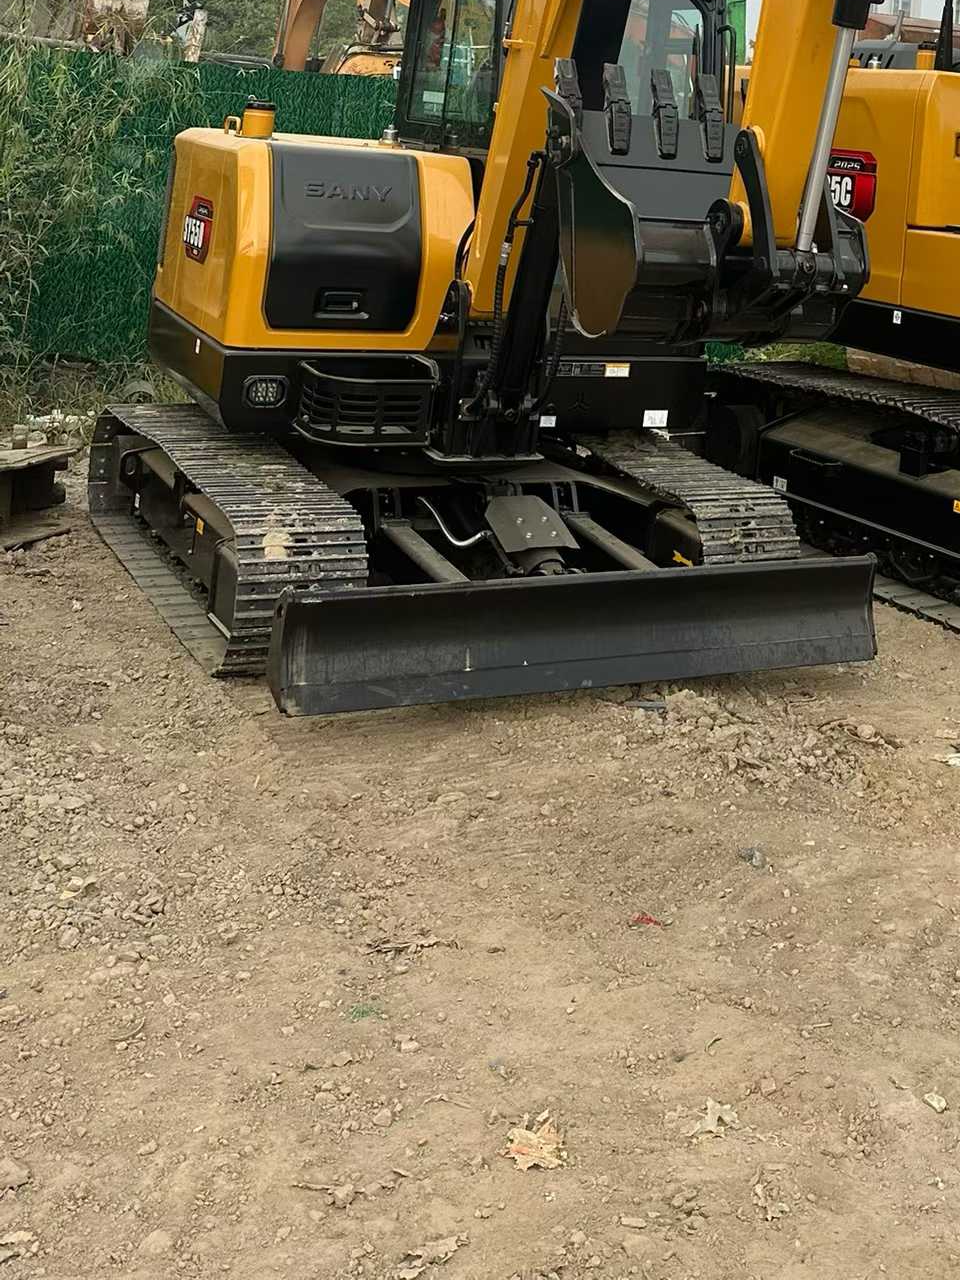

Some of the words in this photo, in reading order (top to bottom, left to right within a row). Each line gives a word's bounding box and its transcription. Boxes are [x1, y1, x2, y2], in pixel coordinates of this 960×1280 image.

[833, 160, 861, 170] 2025
[304, 181, 393, 202] SANY
[826, 174, 852, 207] 5C
